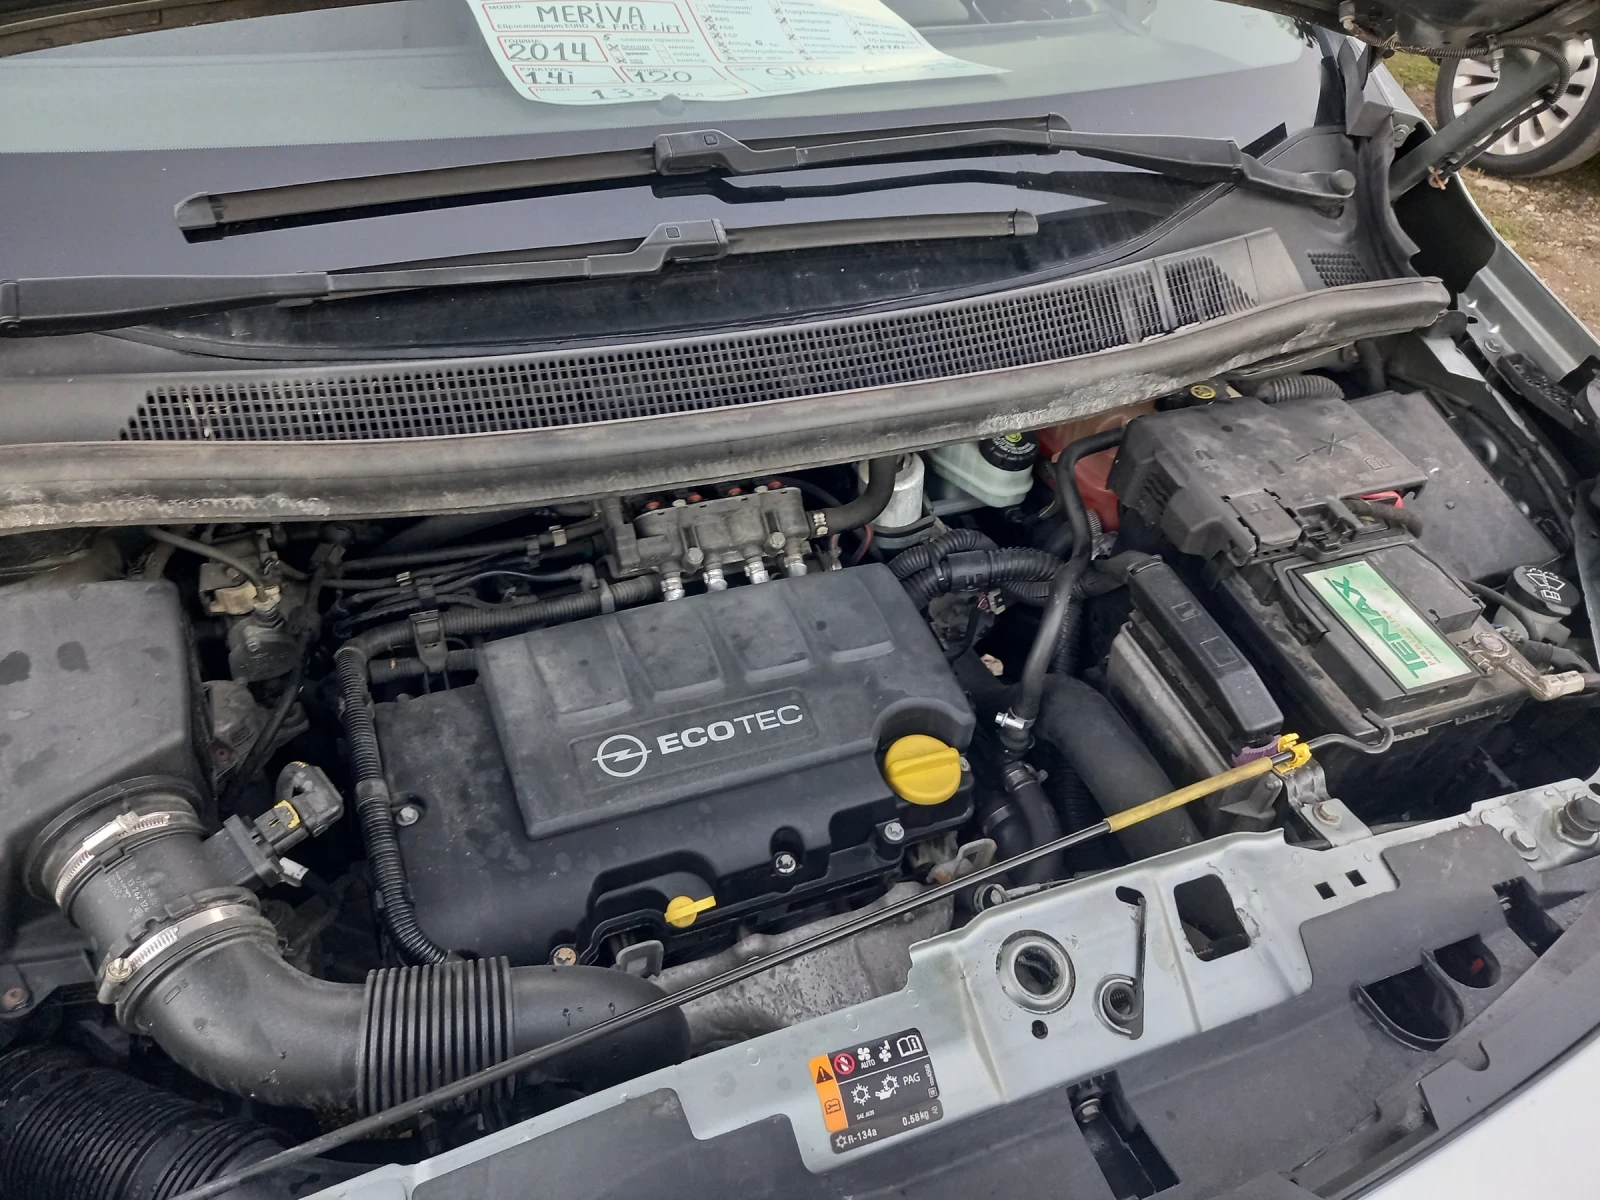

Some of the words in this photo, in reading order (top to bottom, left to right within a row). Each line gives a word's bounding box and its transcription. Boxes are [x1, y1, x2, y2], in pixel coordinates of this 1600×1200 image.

[508, 42, 590, 62] 2014
[634, 71, 693, 83] 120
[591, 87, 658, 99] 133
[1323, 576, 1429, 679] TENAX
[656, 704, 803, 755] ECOTEC
[860, 1059, 876, 1070] AUTO
[902, 1072, 921, 1086] PAG
[847, 1128, 878, 1145] R-134a
